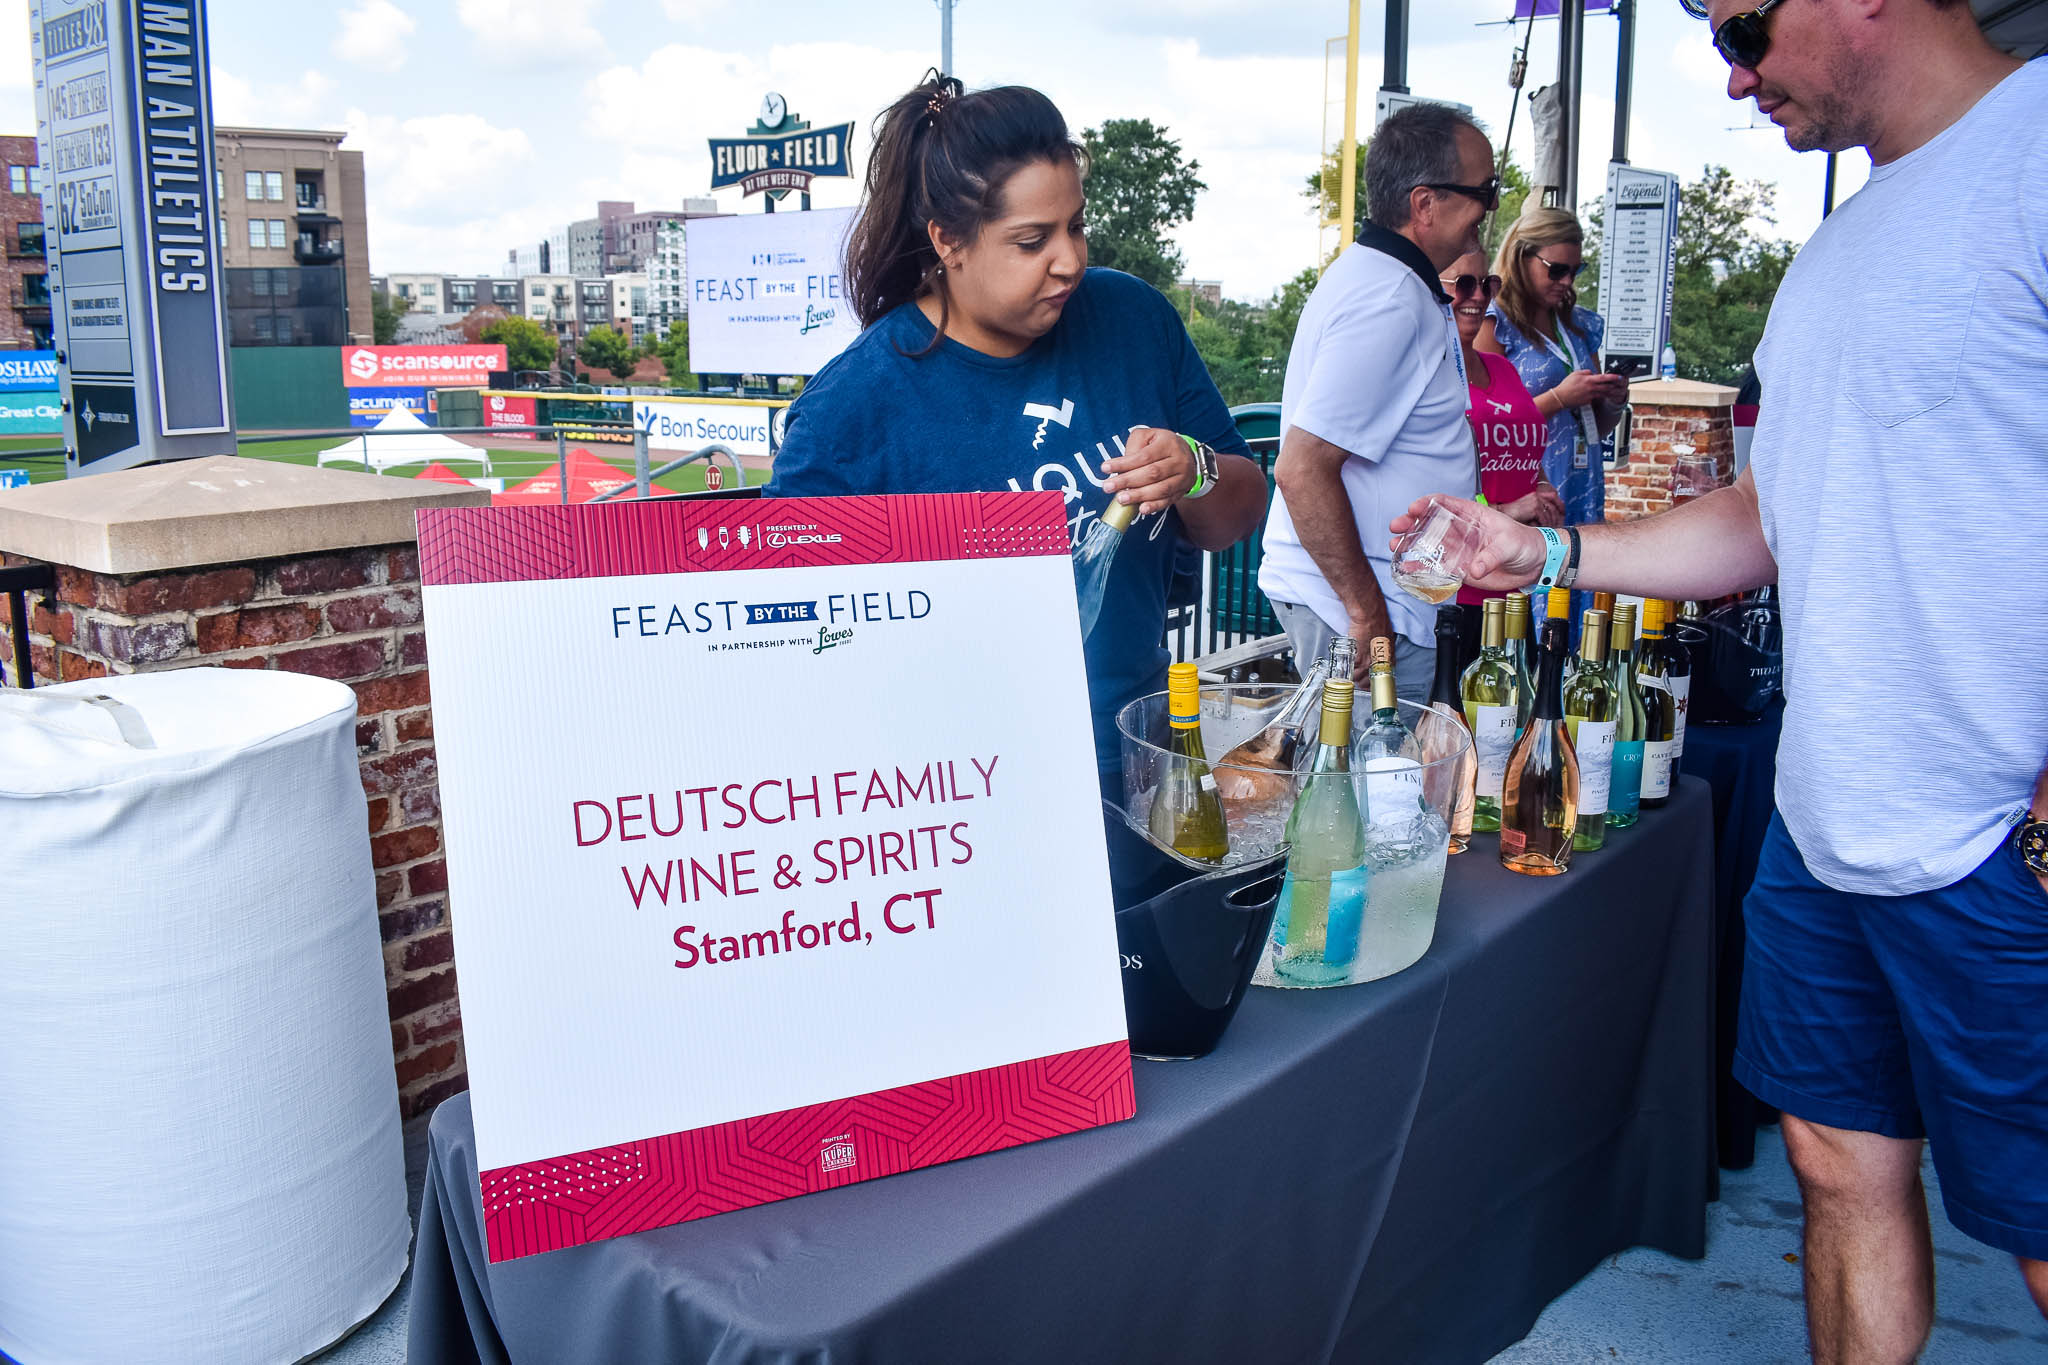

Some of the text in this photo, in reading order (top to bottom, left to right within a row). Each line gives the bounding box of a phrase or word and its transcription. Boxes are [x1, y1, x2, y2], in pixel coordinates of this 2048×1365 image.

[91, 123, 111, 167] 133
[143, 3, 207, 292] MAN ATHLETICS
[717, 133, 838, 176] FLUOR FIELD
[745, 174, 805, 192] AT THE WEST END
[58, 181, 79, 235] 62
[695, 278, 758, 302] FEAST
[766, 283, 778, 294] BY
[779, 283, 796, 294] THE
[381, 354, 498, 371] scansource
[0, 405, 63, 420] Great Clip
[491, 413, 503, 422] THE
[660, 415, 766, 442] Bon Secours
[1478, 423, 1549, 448] IQUID
[706, 472, 721, 485] 117
[766, 524, 807, 532] PRESENTED
[788, 533, 842, 545] LEXUS
[612, 590, 932, 638] FEAST BY THE FIELD
[708, 637, 813, 652] IN PARTNERSHIP WITH
[812, 626, 854, 655] Lowes
[573, 755, 999, 846] DEUTSCH FAMILY
[621, 822, 973, 911] WINE & SPIRITS
[673, 888, 942, 969] Stamford, CT
